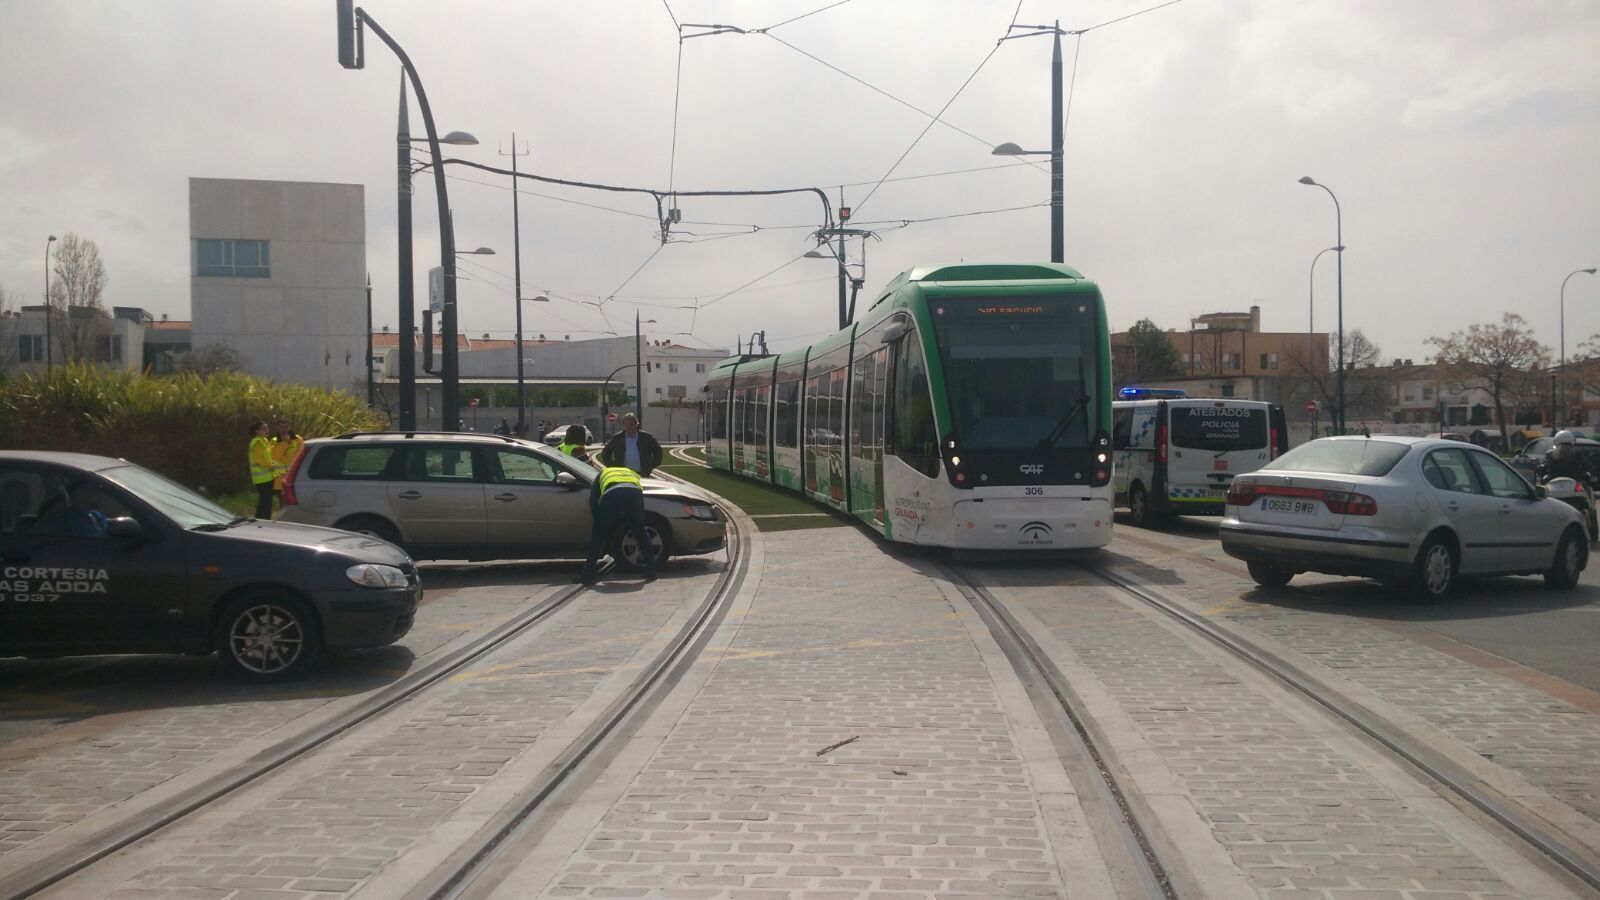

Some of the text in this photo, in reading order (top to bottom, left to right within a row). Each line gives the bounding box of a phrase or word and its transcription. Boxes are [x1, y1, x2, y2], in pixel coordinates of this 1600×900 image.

[1189, 408, 1250, 418] ATESTADOS
[1201, 420, 1240, 429] POLICIA
[1020, 464, 1044, 475] CAF
[1025, 487, 1043, 495] 306
[1268, 500, 1292, 511] 0683
[4, 567, 109, 580] CORTESIA
[38, 581, 107, 593] ADDA
[14, 594, 60, 602] 037
